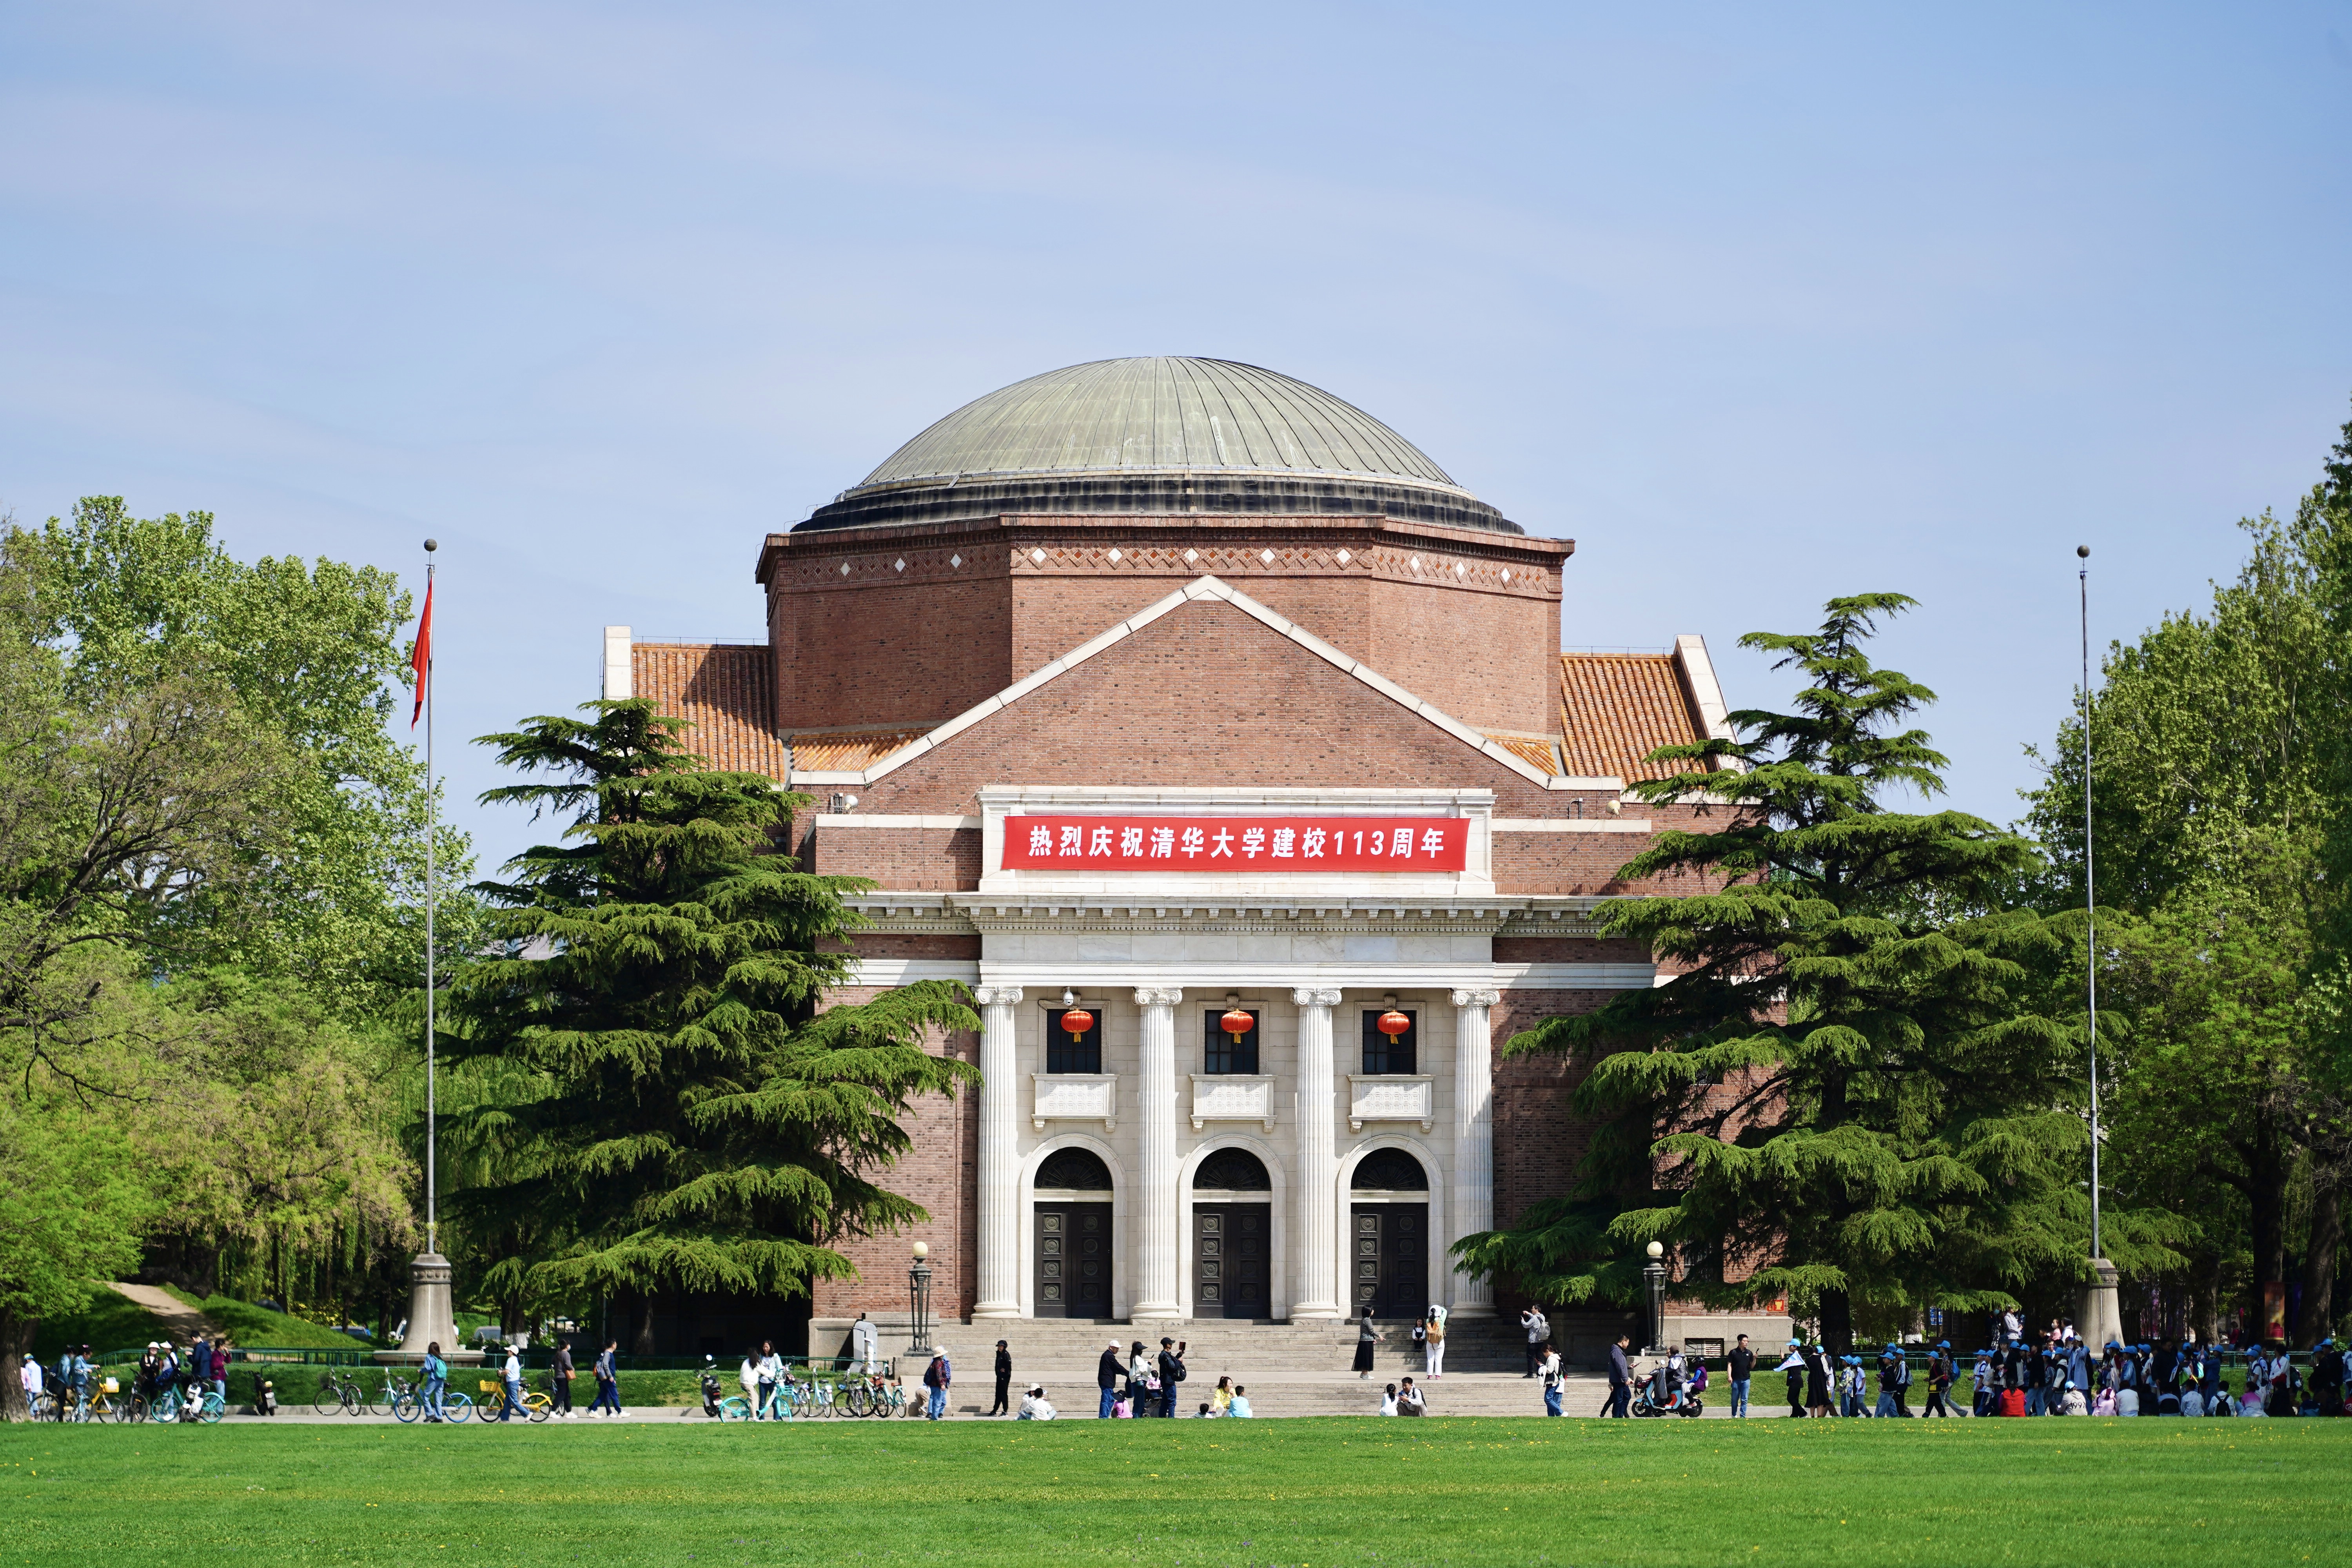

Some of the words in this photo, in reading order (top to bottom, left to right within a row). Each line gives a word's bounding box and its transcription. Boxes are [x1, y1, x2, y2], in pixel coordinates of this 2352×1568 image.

[1028, 825, 1444, 858] 热烈庆祝清华大学建校113周年
